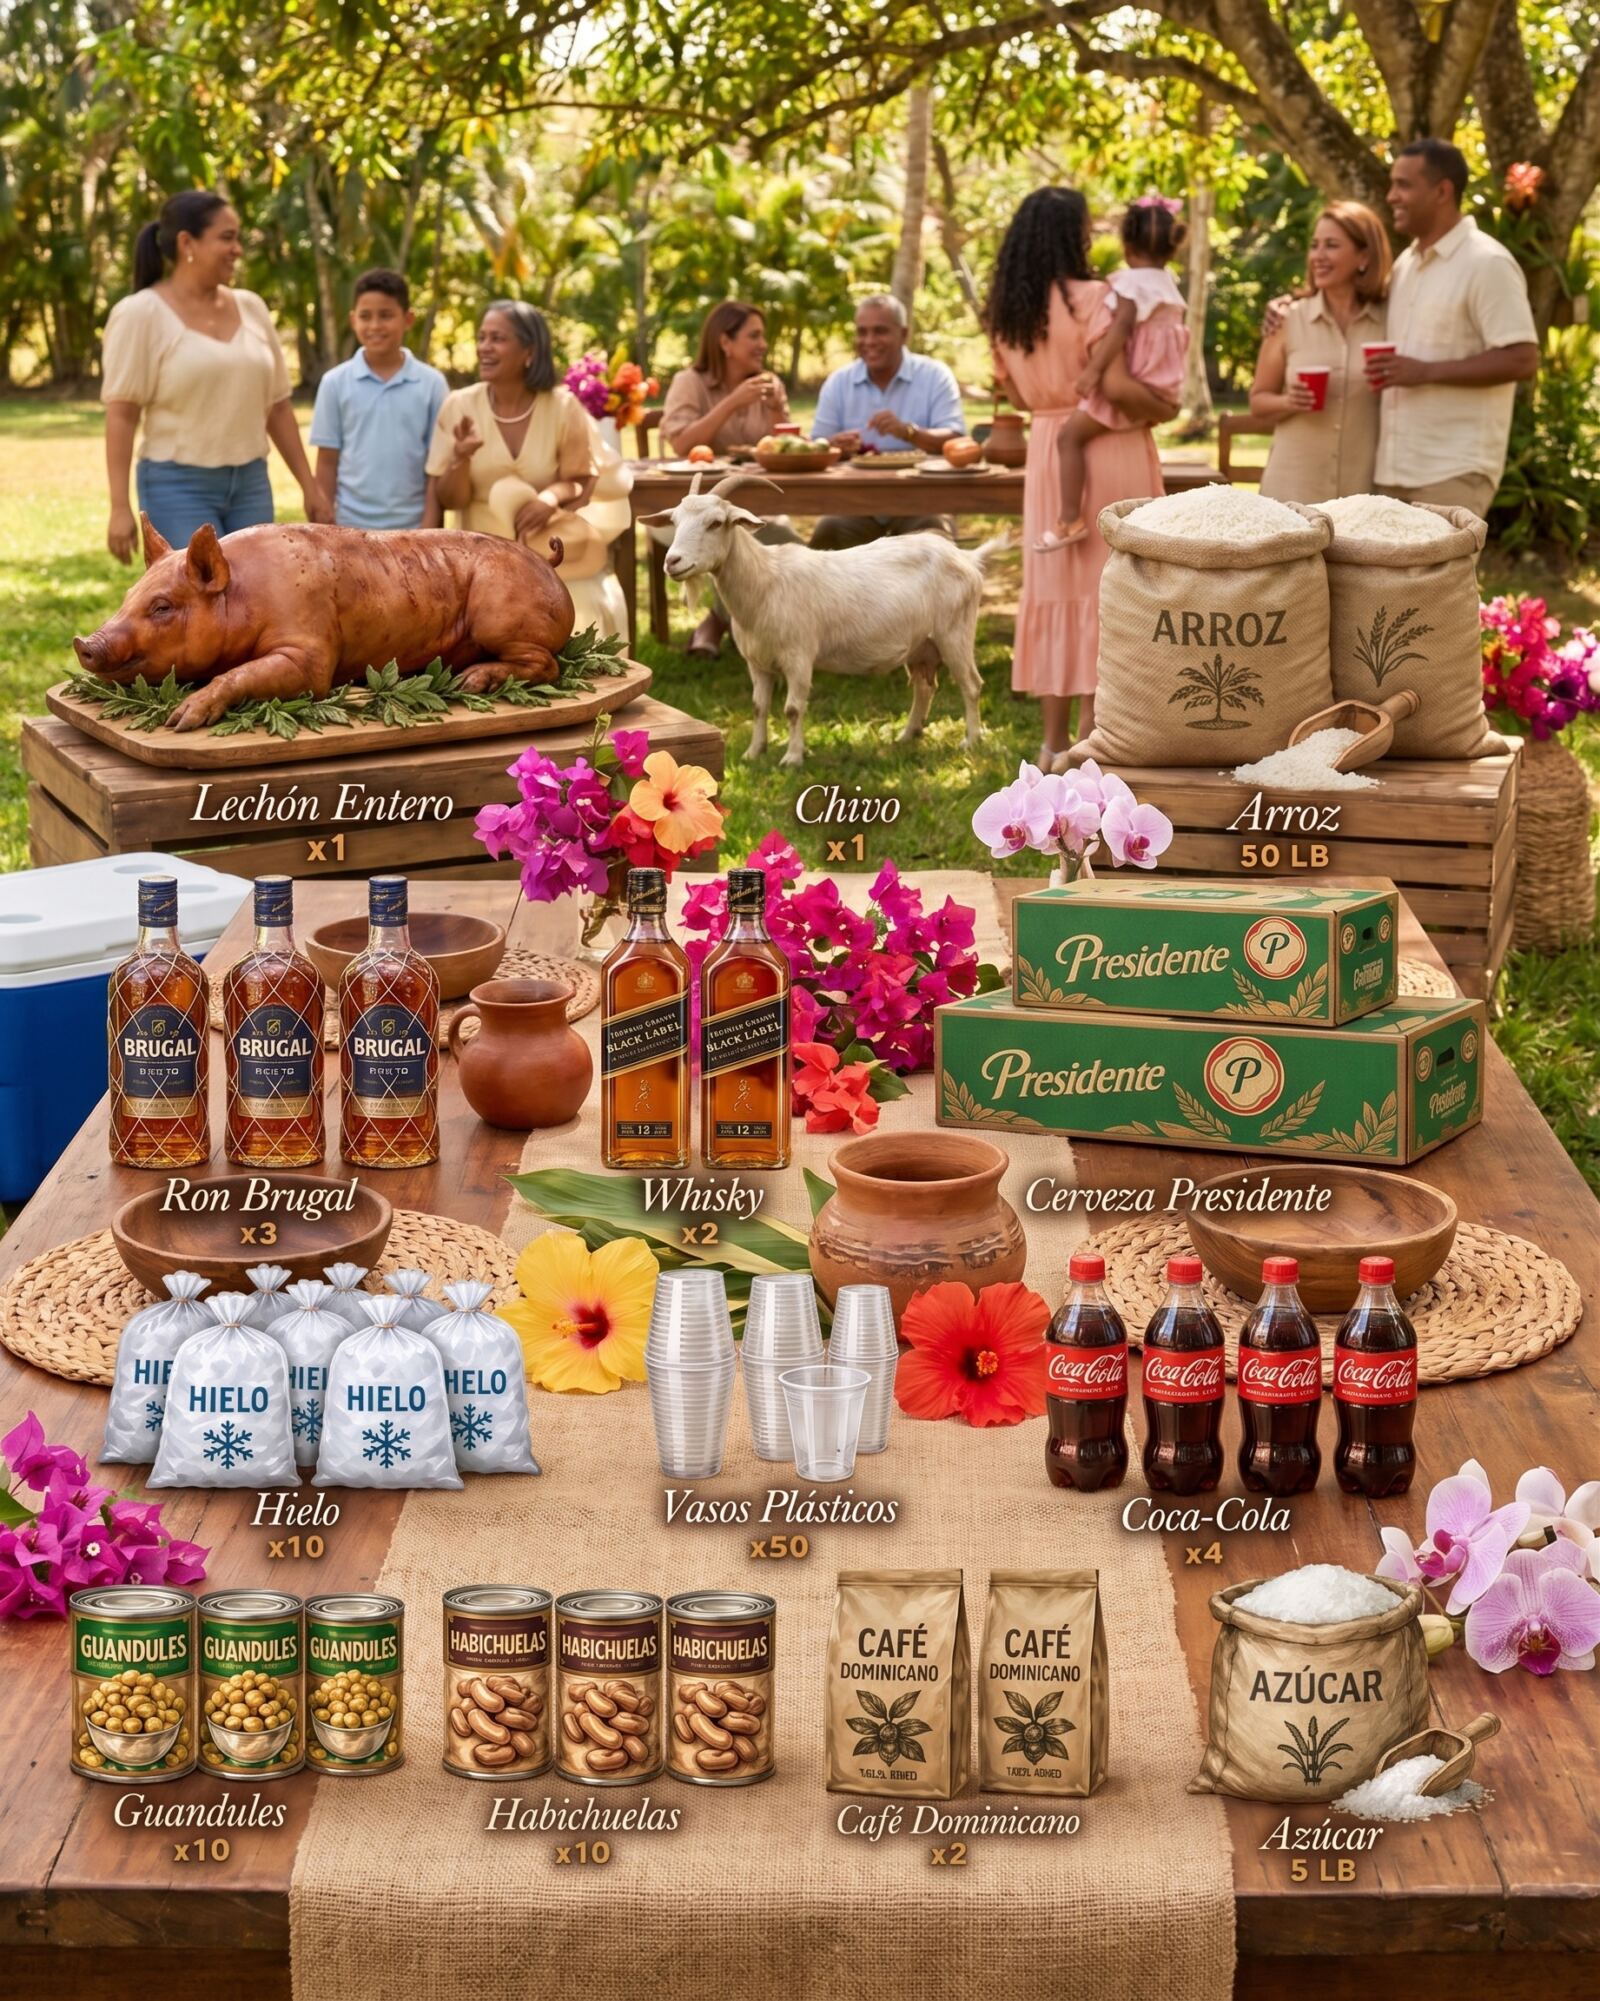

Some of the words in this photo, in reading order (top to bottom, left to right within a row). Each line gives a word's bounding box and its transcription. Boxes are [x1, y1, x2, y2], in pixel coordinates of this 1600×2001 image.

[1152, 609, 1287, 647] ARROZ
[1054, 933, 1231, 984] Presidente
[1260, 931, 1290, 965] P
[125, 1037, 197, 1058] BRUGAL
[239, 1037, 312, 1058] BRUGAL
[354, 1037, 426, 1058] BRUGAL
[606, 1034, 643, 1054] BLACK
[644, 1021, 683, 1041] LABEL
[706, 1034, 743, 1054] BLACK
[744, 1021, 783, 1041] LABEL
[980, 1048, 1166, 1100] Presidente
[1225, 1056, 1262, 1095] P
[1048, 1353, 1124, 1386] Coca-Cola
[1145, 1356, 1221, 1388] Coca-Cola
[1241, 1357, 1318, 1389] Coca-Cola
[1337, 1357, 1413, 1390] Coca-Cola
[189, 1385, 268, 1413] HIELO
[347, 1385, 426, 1412] HIELO
[80, 1633, 187, 1663] GUANDULES
[204, 1635, 297, 1663] GUANDULES
[310, 1635, 397, 1662] GUANDULES
[451, 1630, 547, 1655] HABICHUELAS
[562, 1634, 657, 1660] HABICHUELAS
[673, 1635, 768, 1661] HABICHUELAS
[858, 1623, 928, 1659] CAFÉ
[1004, 1624, 1072, 1659] CAFÉ
[840, 1662, 939, 1682] DOMINICANO
[990, 1663, 1081, 1682] DOMINICANO
[1249, 1665, 1384, 1704] AZÚCAR
